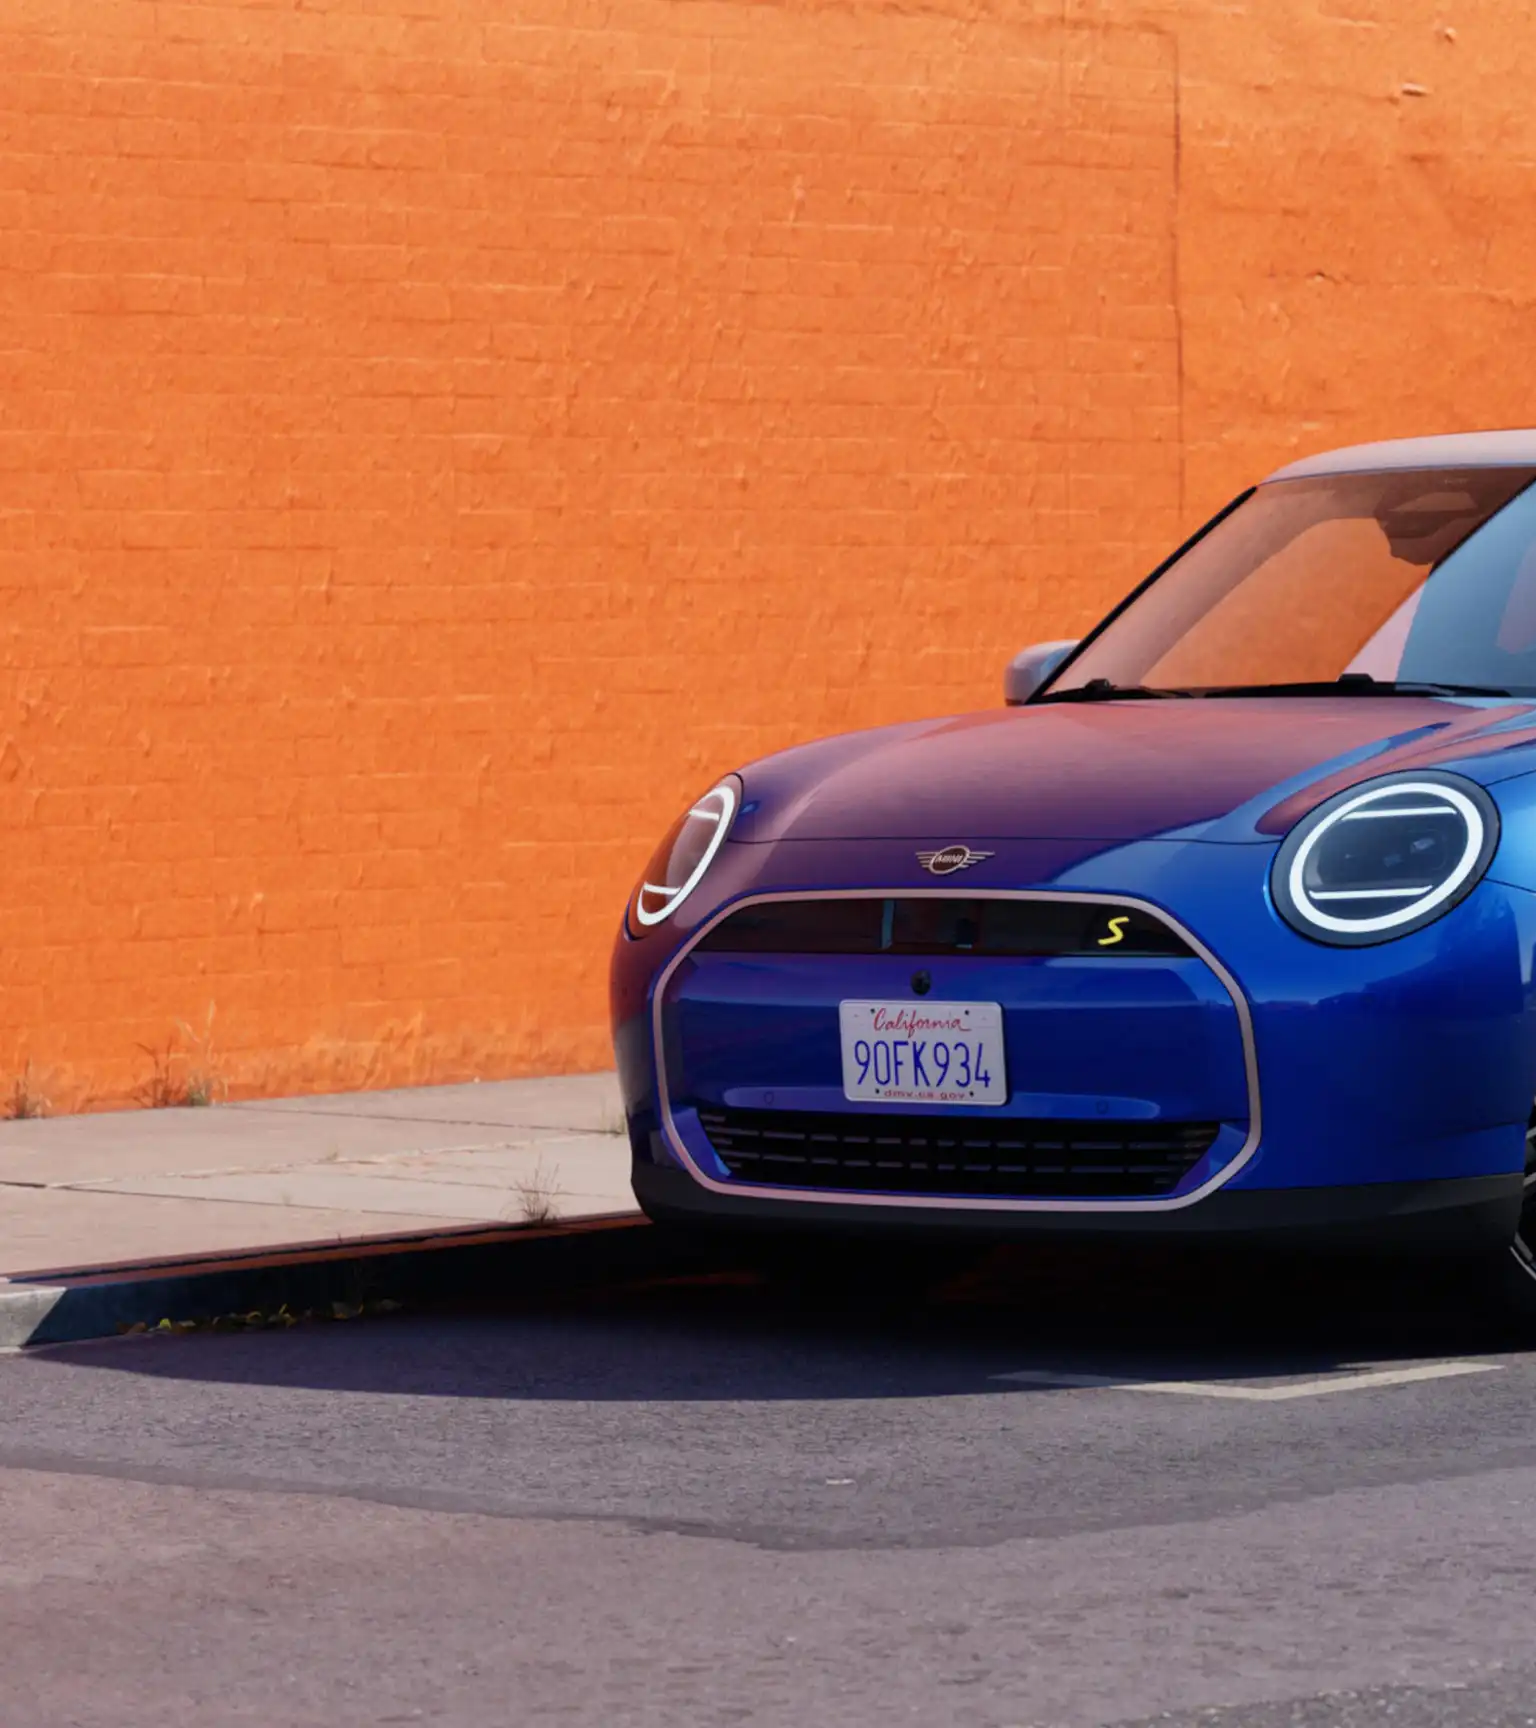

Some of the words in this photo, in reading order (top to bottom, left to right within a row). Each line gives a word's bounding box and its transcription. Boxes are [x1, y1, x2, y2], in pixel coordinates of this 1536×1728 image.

[1098, 916, 1130, 946] S
[873, 1008, 972, 1038] California
[854, 1040, 991, 1088] 90FK934
[884, 1089, 966, 1100] dmv.cagov
